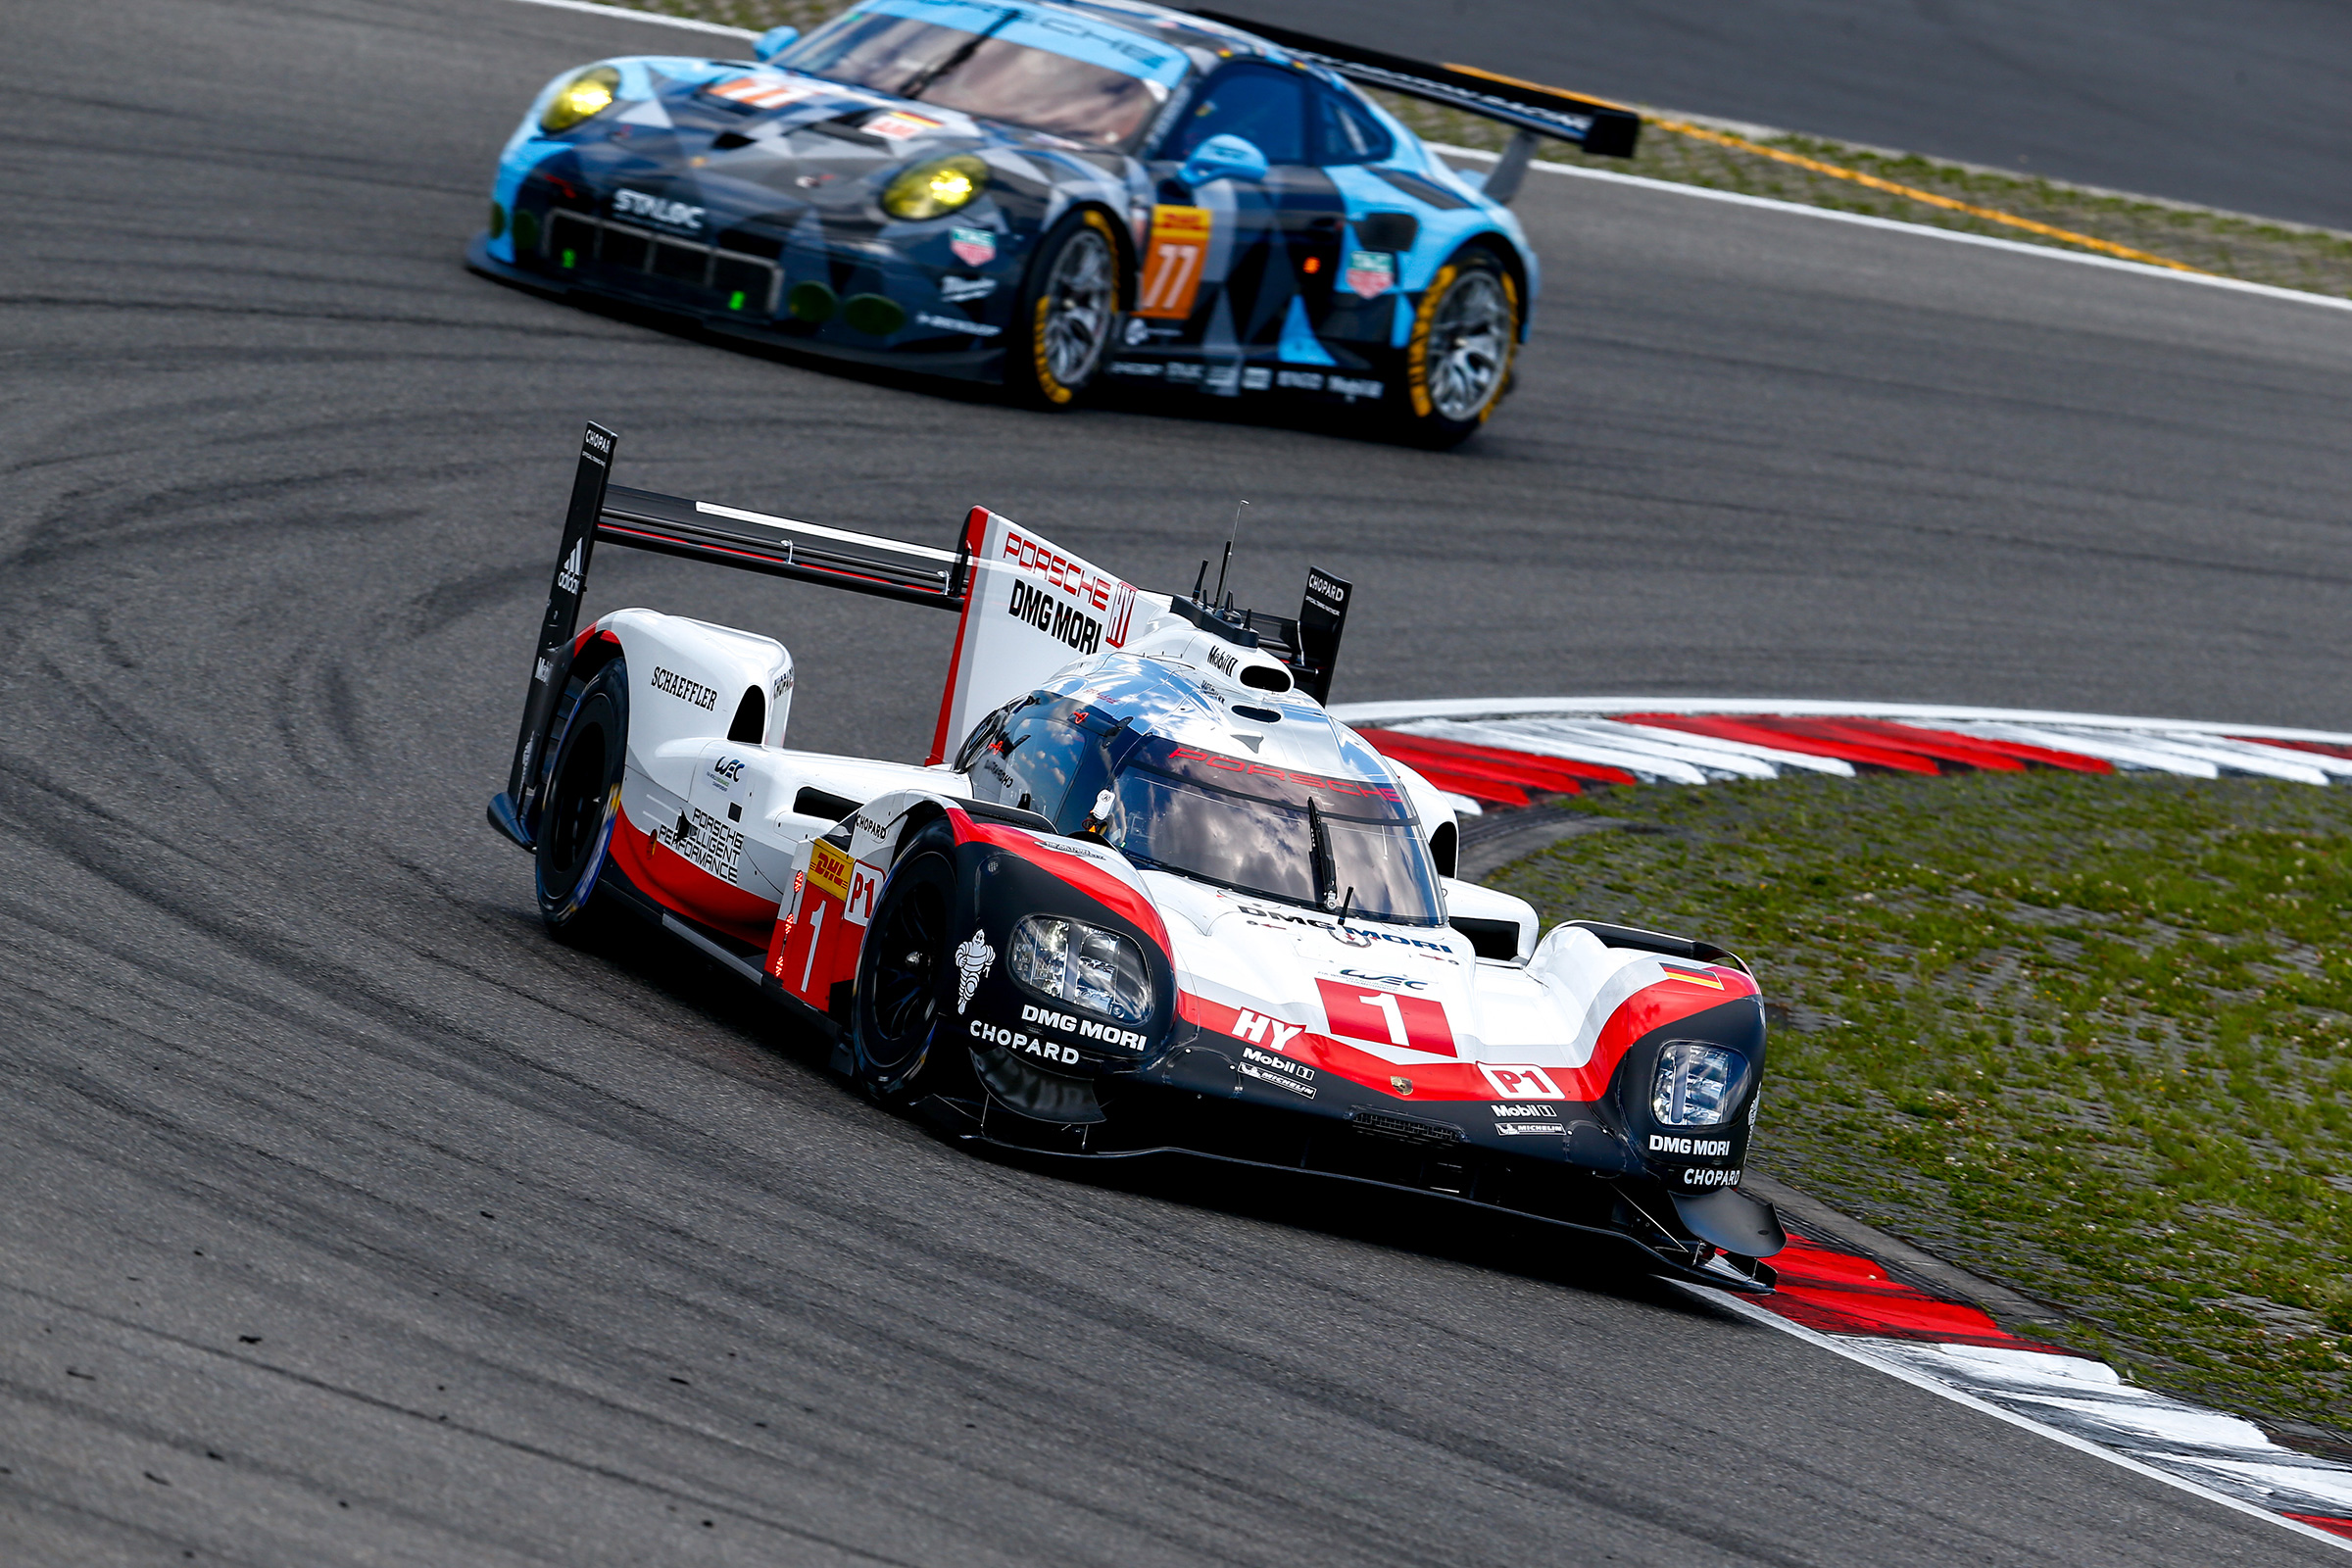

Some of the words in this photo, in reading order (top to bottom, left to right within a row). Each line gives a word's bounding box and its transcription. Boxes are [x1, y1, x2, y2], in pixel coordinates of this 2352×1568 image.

[1142, 242, 1200, 310] 77
[1004, 531, 1110, 612] PORSCHE
[1308, 573, 1345, 602] CHOPARD
[1008, 578, 1054, 632] DMG
[1051, 600, 1102, 655] MORI
[651, 665, 718, 711] SCHAEFFLER
[714, 756, 746, 783] WEC
[1168, 747, 1403, 803] PORSCHE
[692, 807, 745, 851] PORSCHE
[856, 813, 887, 840] CHOPARD
[659, 824, 738, 884] PERFORMANCE
[813, 852, 847, 887] DHL
[849, 871, 875, 919] P1
[800, 900, 827, 993] 1
[1237, 905, 1337, 931] DMG
[1342, 926, 1453, 954] MORI
[1339, 969, 1429, 991] WEC
[969, 1019, 1079, 1064] CHOPARD
[1021, 1004, 1078, 1032] DMG
[1079, 1019, 1148, 1052] MORI
[1231, 1008, 1303, 1052] HY
[1358, 992, 1410, 1047] 1
[1243, 1047, 1296, 1073] Mobil
[1491, 1070, 1551, 1094] P1
[1260, 1072, 1314, 1095] MICHELIN
[1491, 1104, 1541, 1117] Mobil
[1648, 1134, 1691, 1154] DMG
[1692, 1140, 1731, 1156] MORI
[1684, 1168, 1740, 1186] CHOPARD
